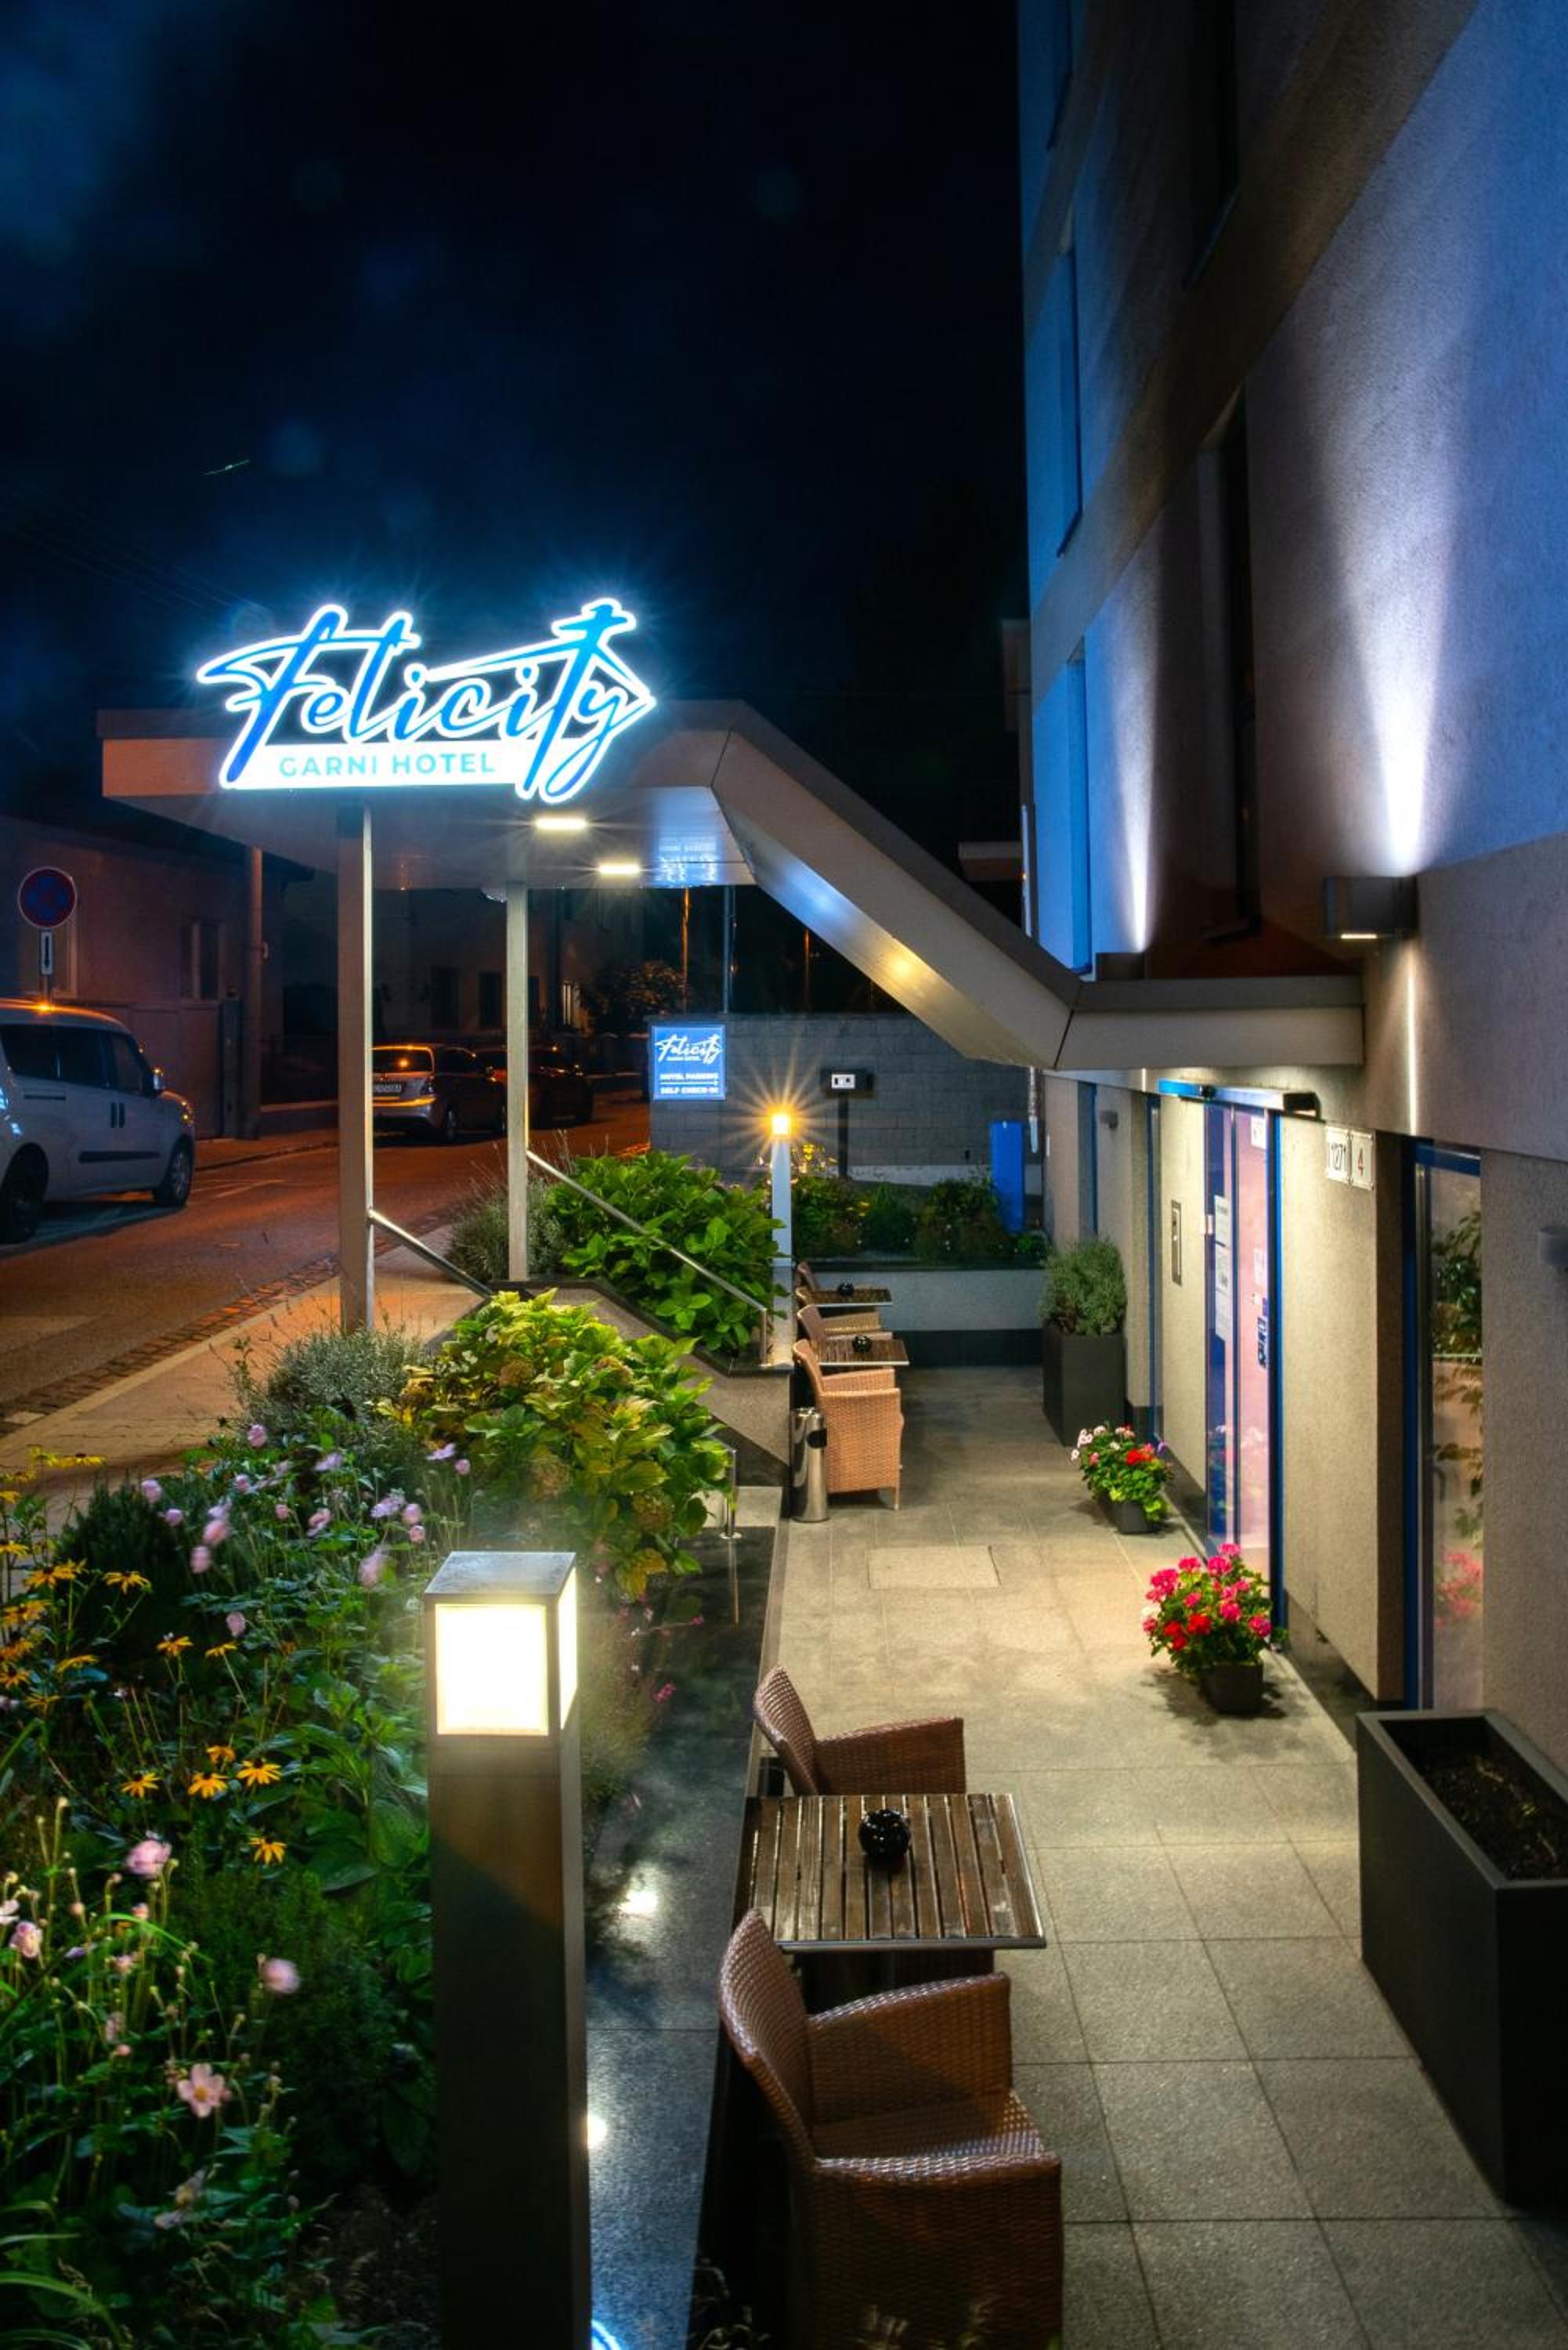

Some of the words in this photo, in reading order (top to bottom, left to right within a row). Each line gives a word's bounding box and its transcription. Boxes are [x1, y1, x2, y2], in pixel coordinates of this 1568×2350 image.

[199, 599, 656, 801] Felicity
[279, 754, 378, 777] GARNI
[392, 751, 496, 775] HOTEL
[1357, 1147, 1364, 1177] 4
